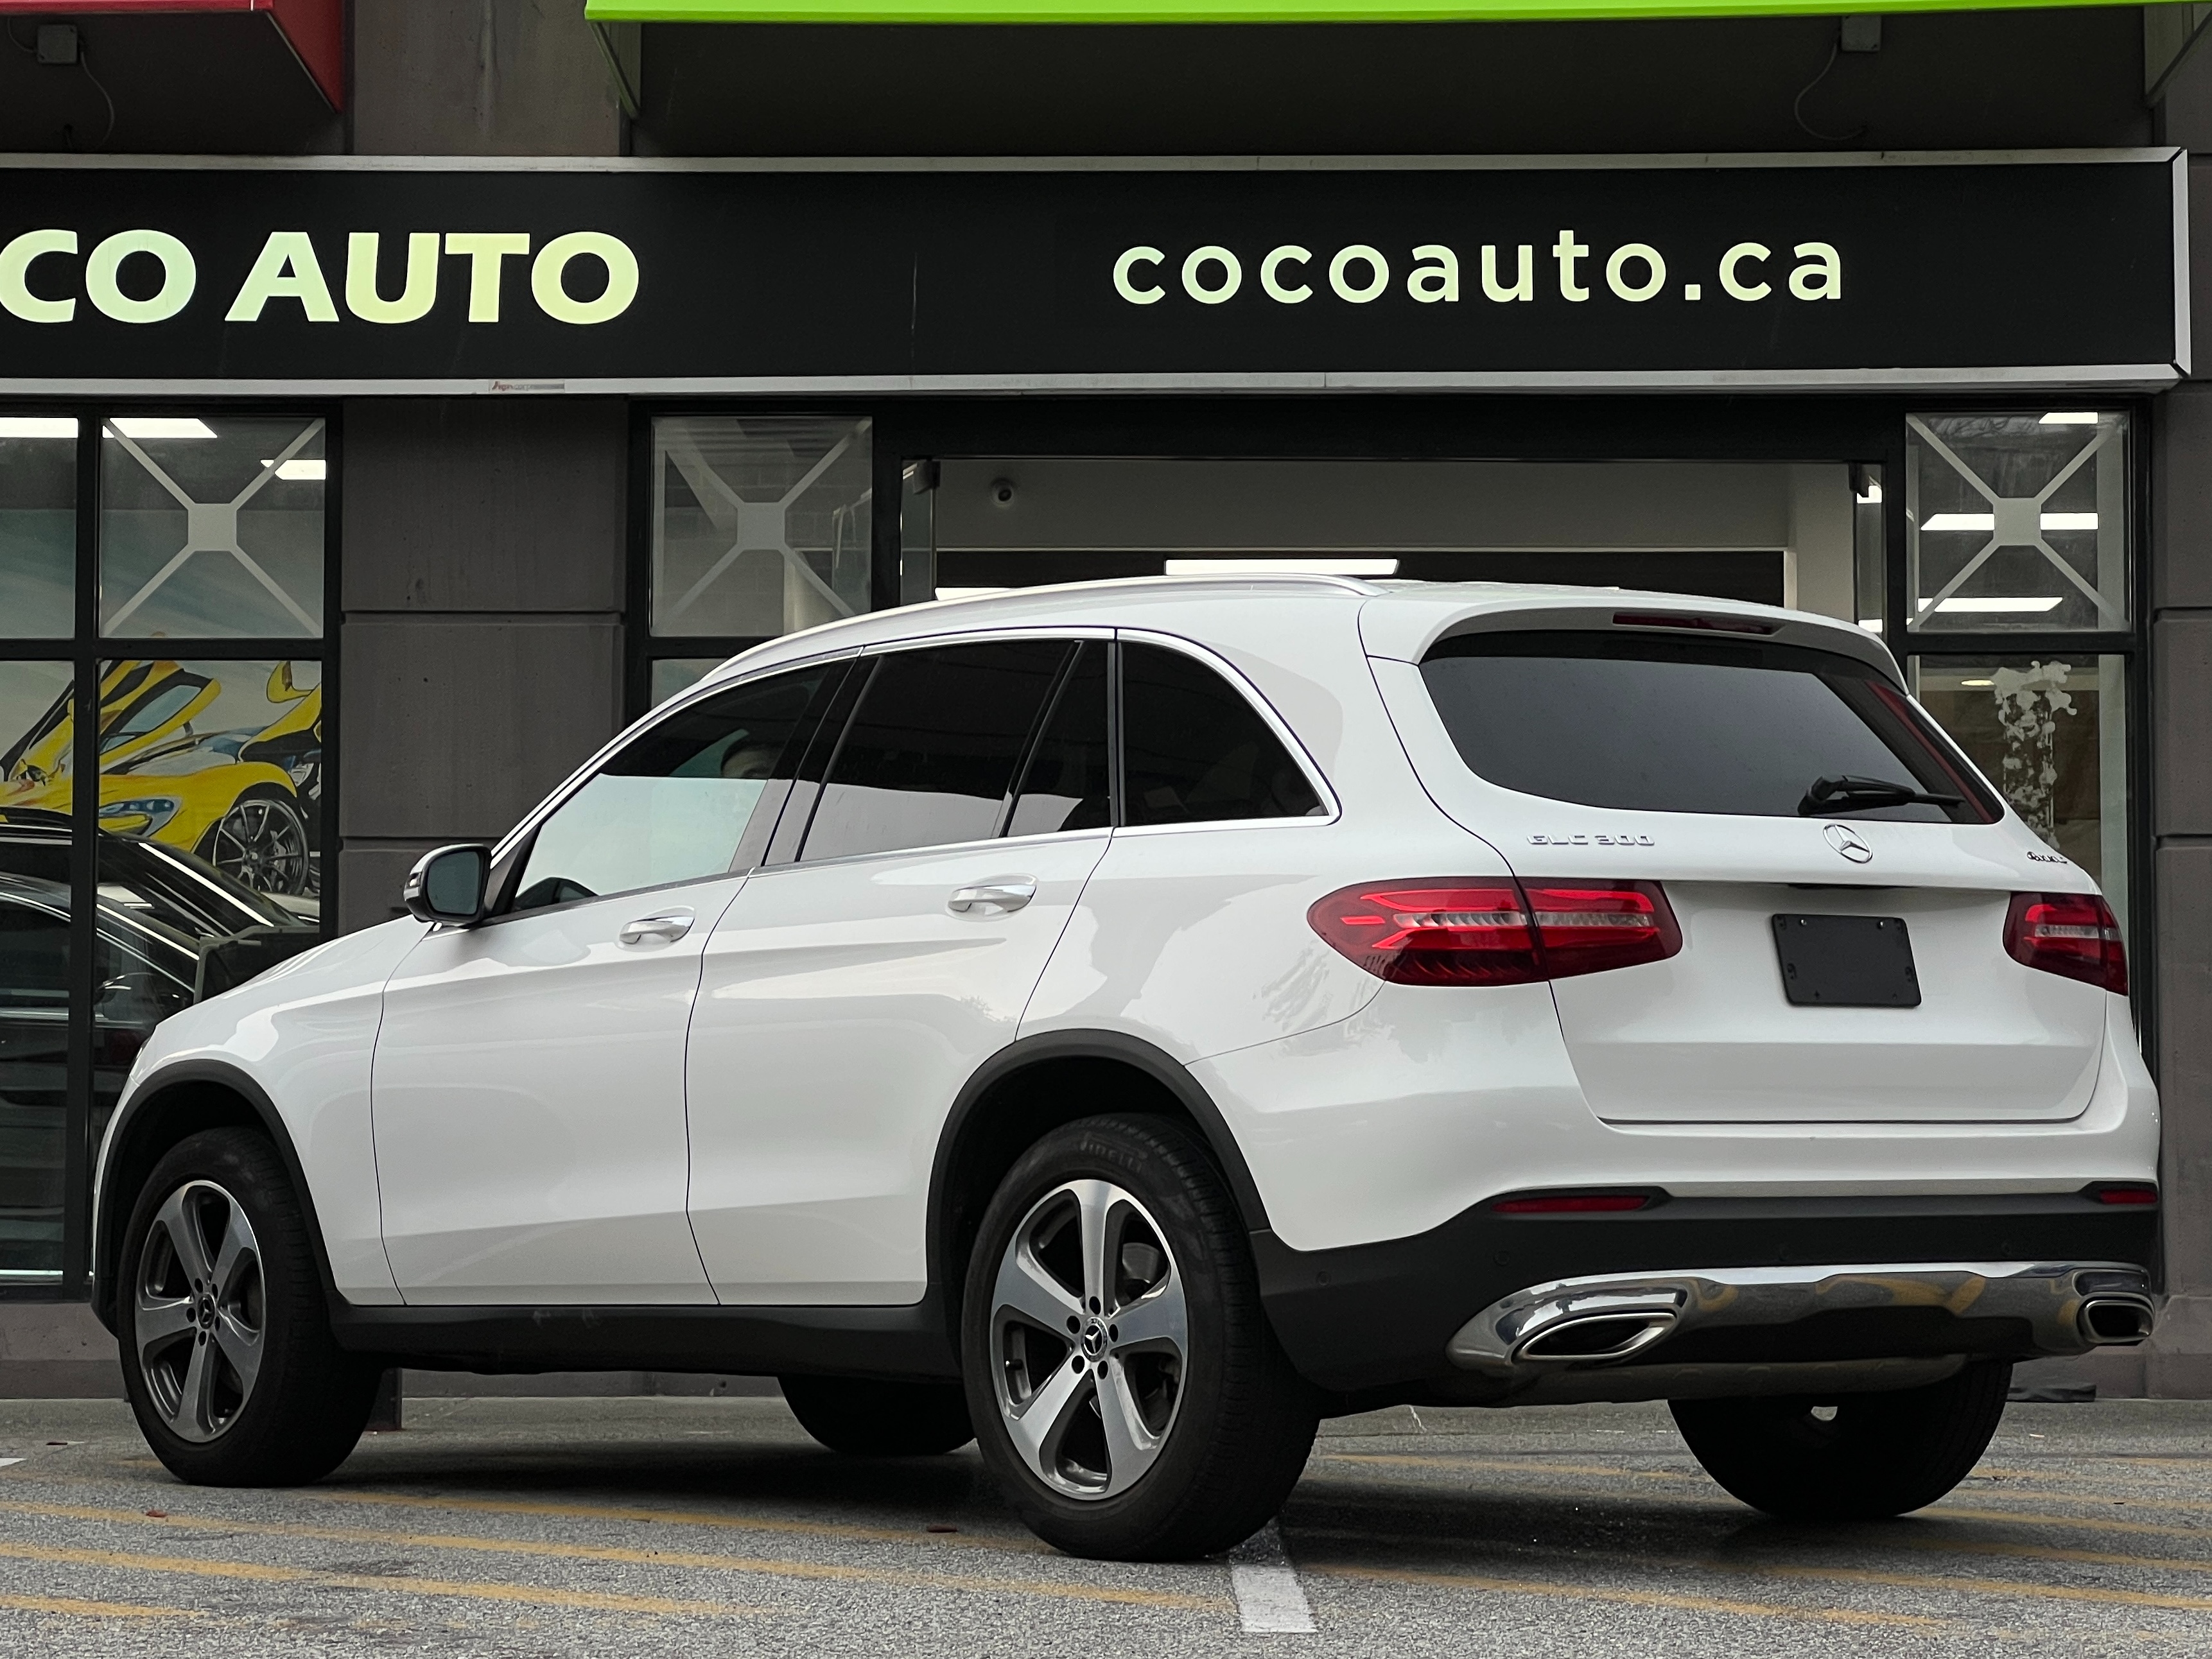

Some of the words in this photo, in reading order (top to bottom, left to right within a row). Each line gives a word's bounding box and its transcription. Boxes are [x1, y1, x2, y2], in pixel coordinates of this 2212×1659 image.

[0, 229, 196, 324] CO
[225, 231, 640, 324] AUTO
[1113, 230, 1841, 304] cocoauto.ca
[1526, 834, 1589, 846] GLC
[1594, 834, 1655, 847] 300
